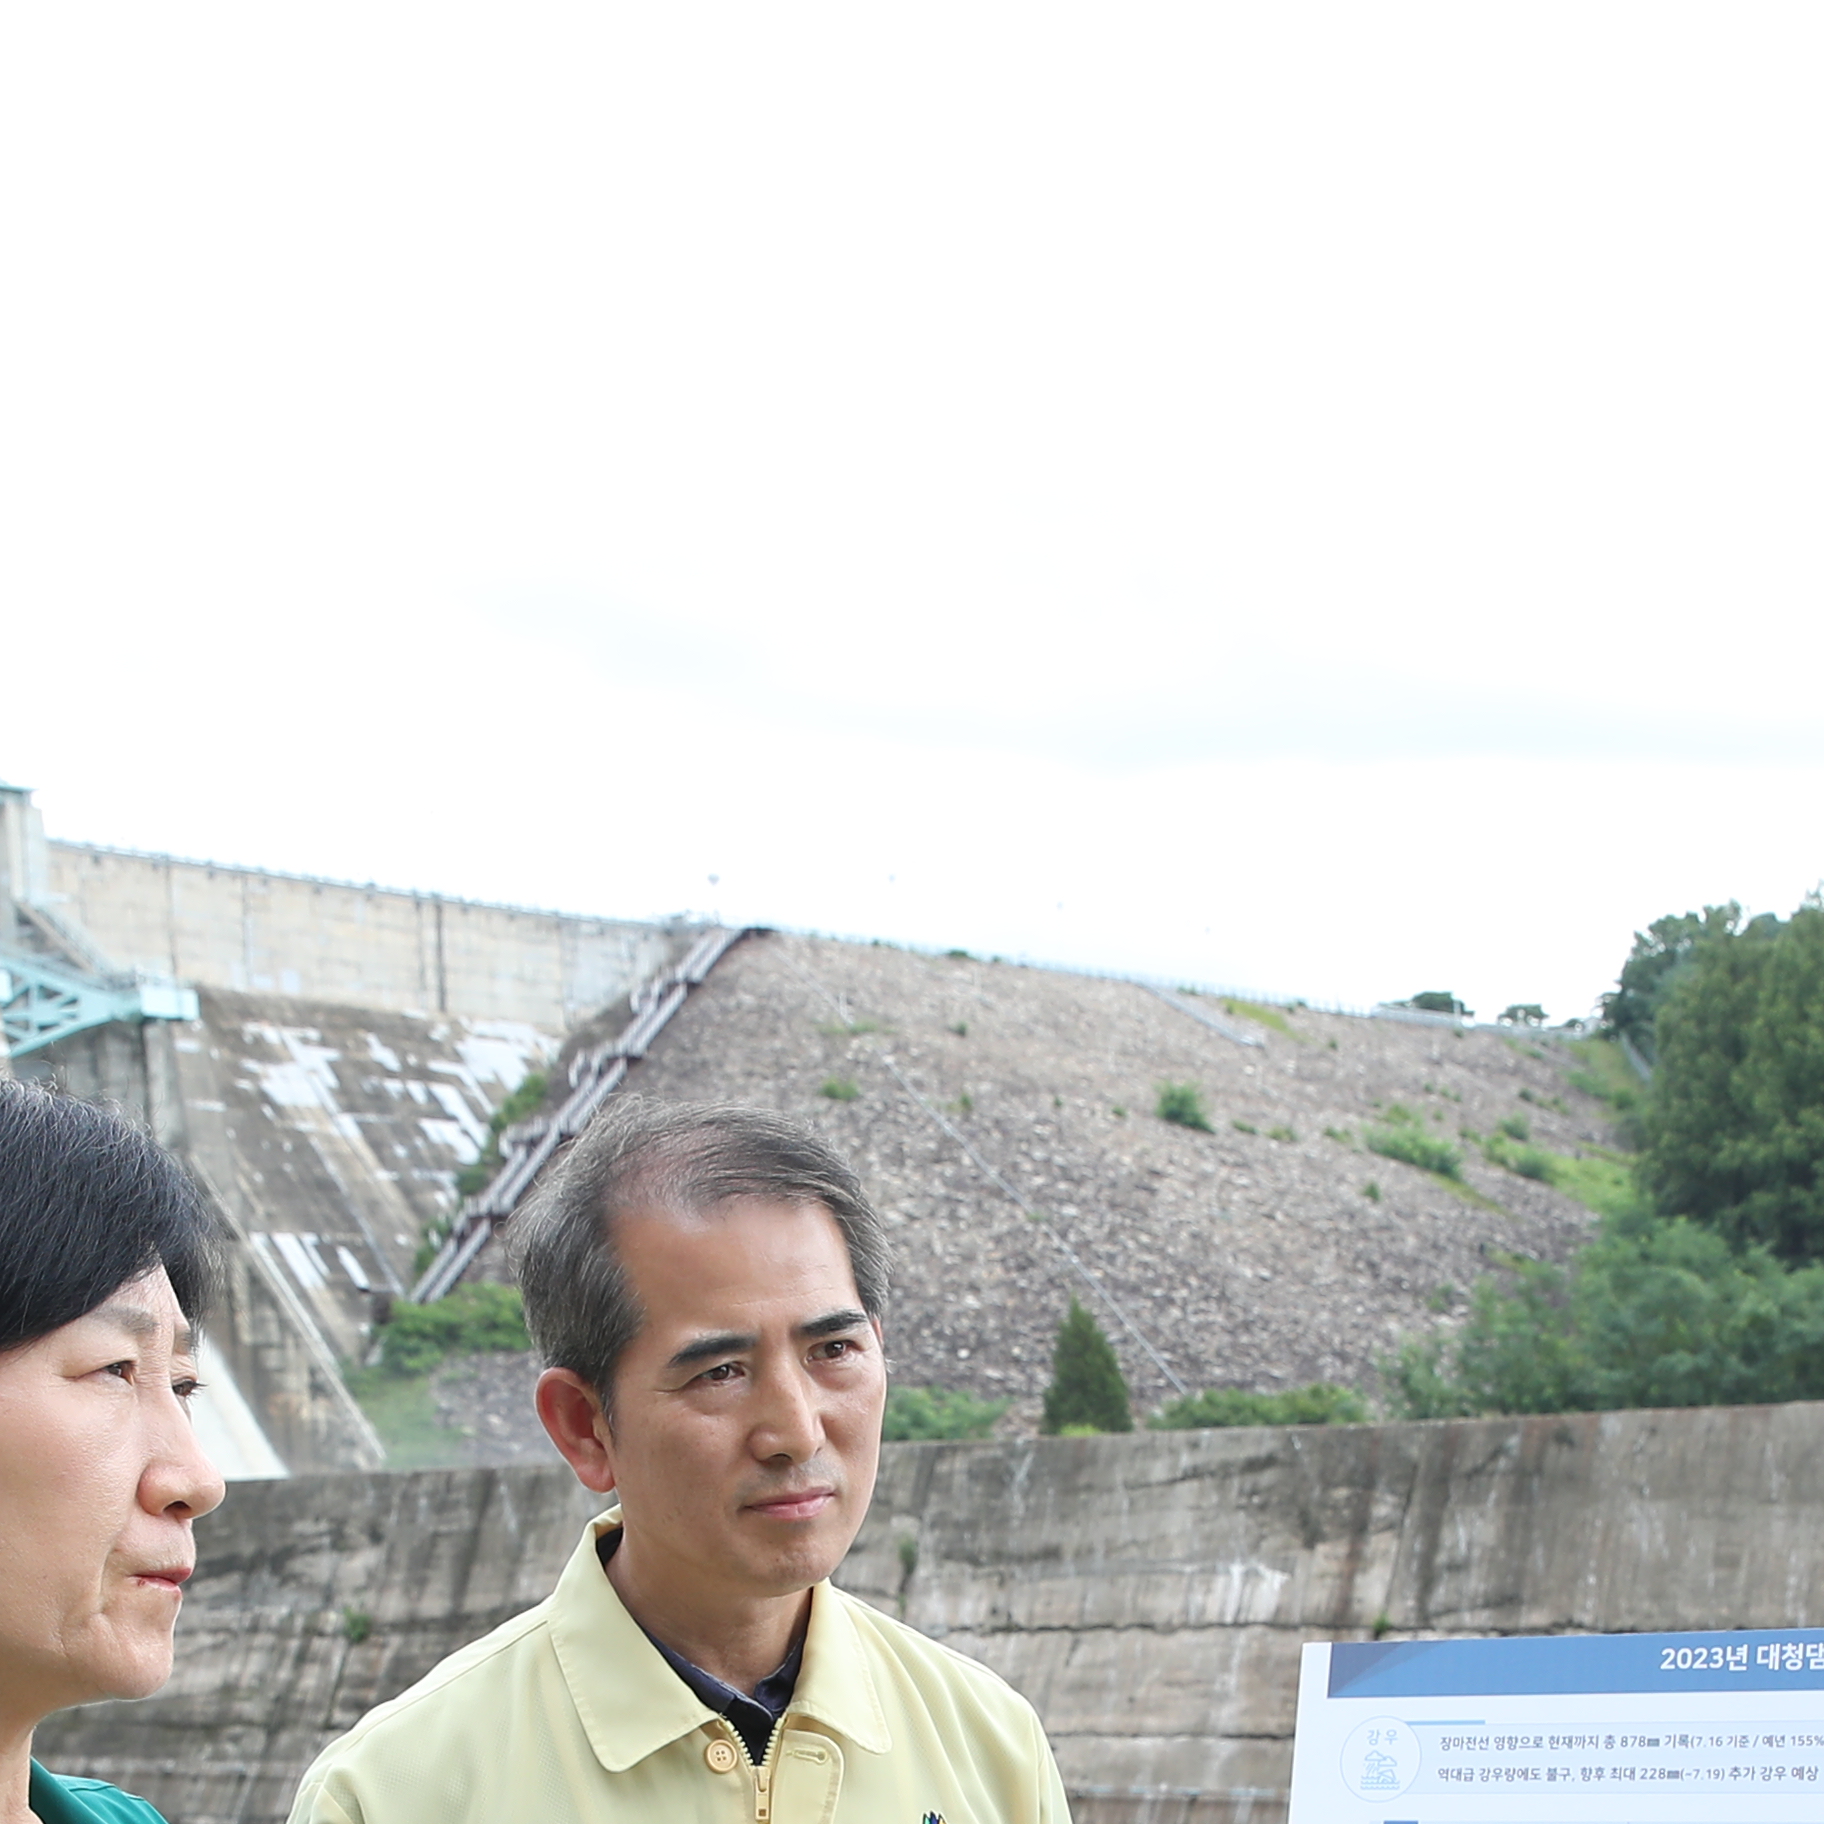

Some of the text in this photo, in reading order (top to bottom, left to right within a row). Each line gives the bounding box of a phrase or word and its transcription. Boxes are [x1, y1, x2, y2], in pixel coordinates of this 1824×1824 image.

[1660, 1645, 1748, 1673] 2023년
[1440, 1736, 1490, 1751] 장마전선
[1494, 1735, 1544, 1750] 영향으로
[1548, 1734, 1599, 1750] 현재까지
[1603, 1734, 1615, 1749] 총
[1726, 1734, 1750, 1748] 기준
[1762, 1734, 1785, 1748] 예년
[1438, 1766, 1818, 1783] 역대급 강우량에도 불구, 향후 최대 추가 강우 예상
